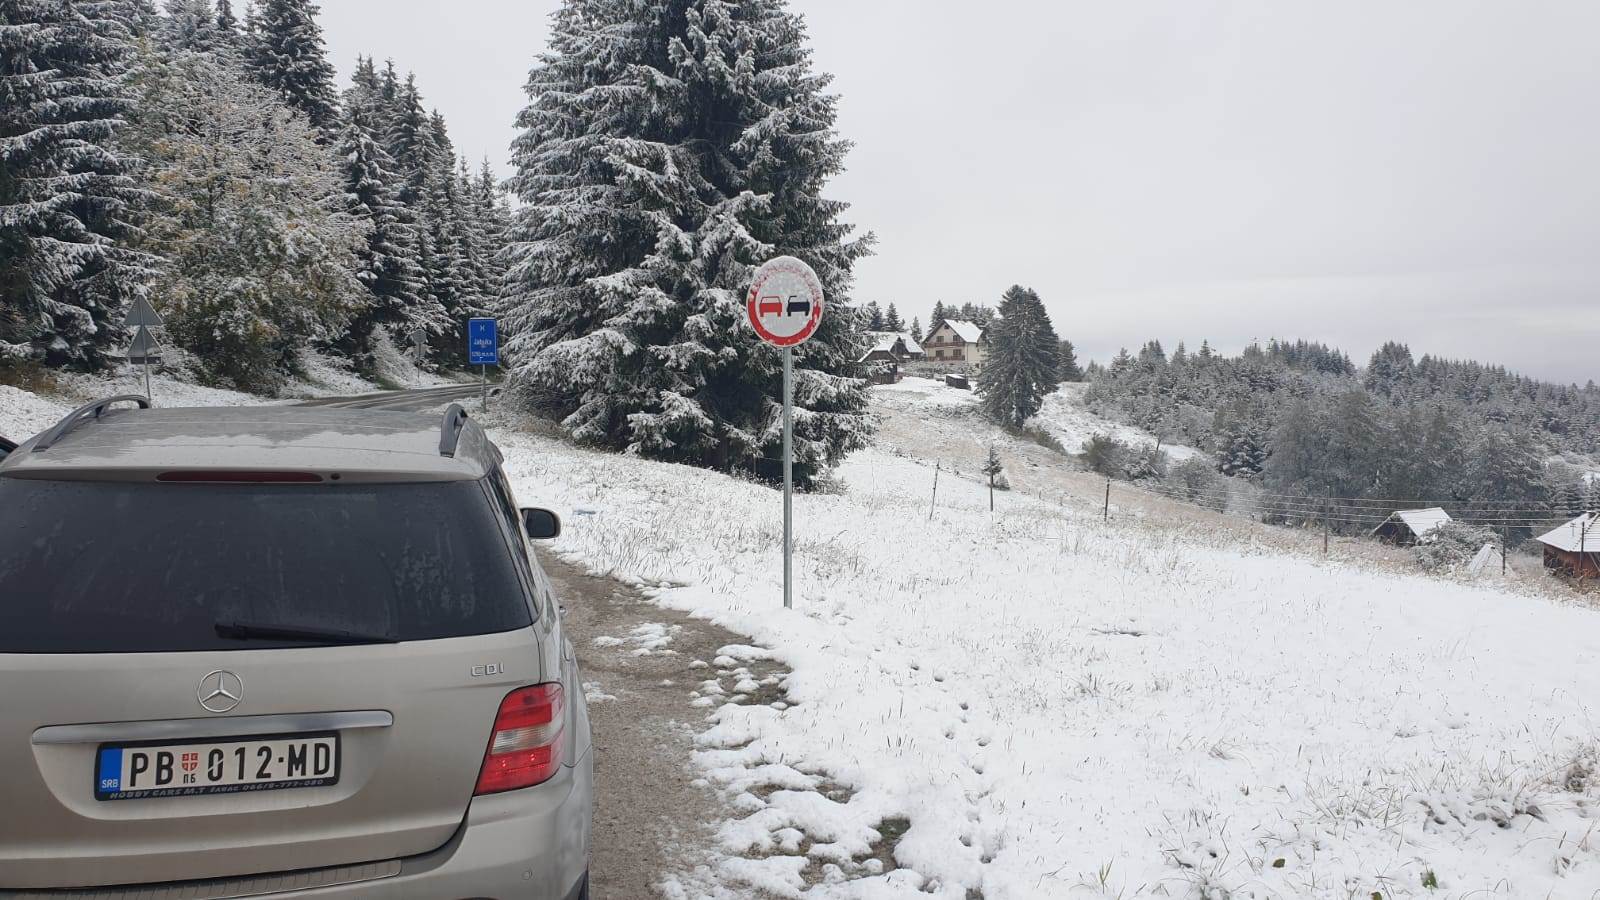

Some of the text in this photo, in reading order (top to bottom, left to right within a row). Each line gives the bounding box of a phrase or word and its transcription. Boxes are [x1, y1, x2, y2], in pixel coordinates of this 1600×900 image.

[471, 660, 504, 677] CDI
[130, 751, 174, 787] PB
[101, 778, 118, 789] SRB
[110, 791, 150, 799] HOBBY
[152, 788, 183, 797] CARS
